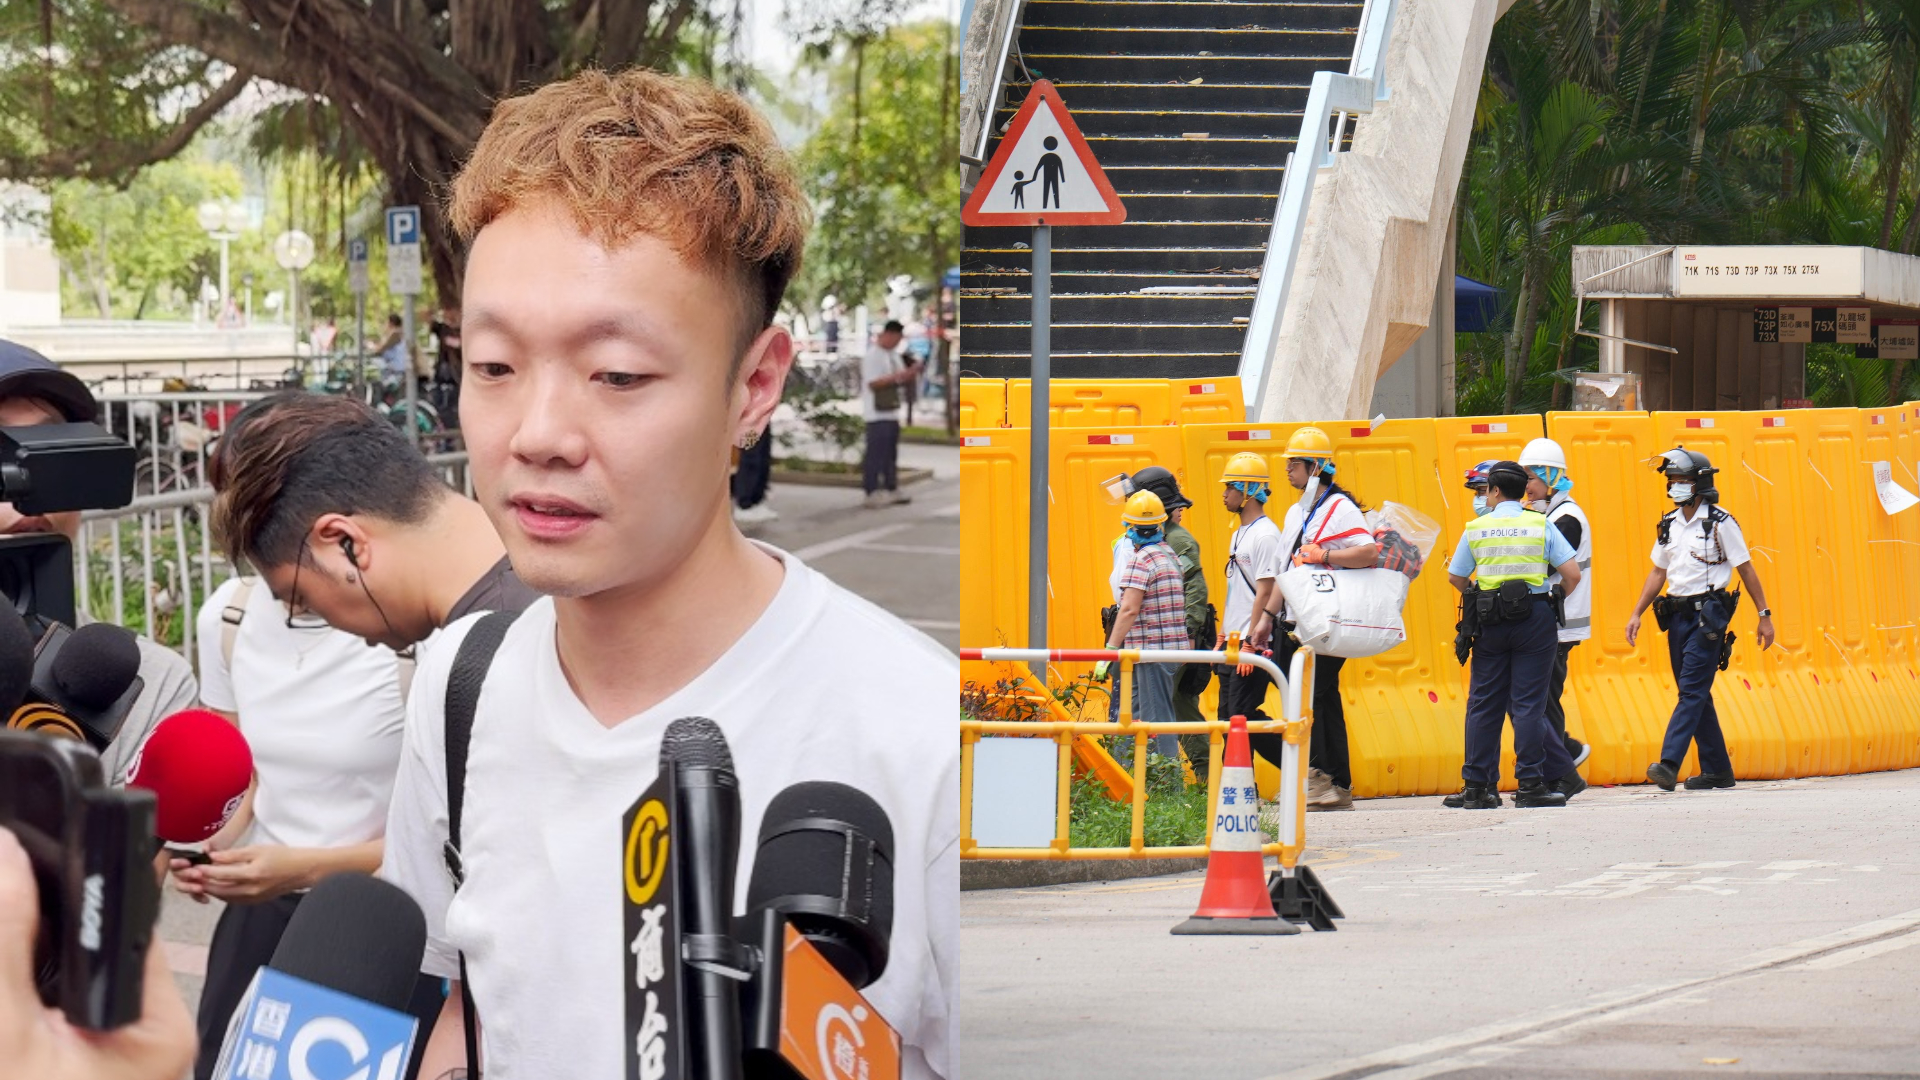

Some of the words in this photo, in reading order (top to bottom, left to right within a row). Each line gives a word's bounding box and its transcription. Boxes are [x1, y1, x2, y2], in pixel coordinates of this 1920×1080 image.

[393, 213, 414, 244] P
[352, 241, 365, 261] P
[1685, 266, 1699, 276] 71K
[1706, 266, 1719, 276] 71S
[1726, 266, 1740, 276] 73D
[1745, 266, 1759, 276] 73P
[1764, 266, 1778, 276] 73X
[1783, 265, 1797, 275] 75X
[1802, 265, 1820, 275] 275X
[1758, 310, 1777, 320] 73D
[1838, 312, 1866, 322] 九龍城
[1758, 321, 1776, 331] 73P
[1814, 320, 1835, 332] 75X
[1838, 321, 1857, 332] 碼頭
[1758, 332, 1776, 342] 73X
[1880, 336, 1915, 346] 大埔墟站
[1490, 528, 1518, 537] POLICE
[1222, 786, 1256, 805] 警察
[1216, 814, 1260, 833] POLIC
